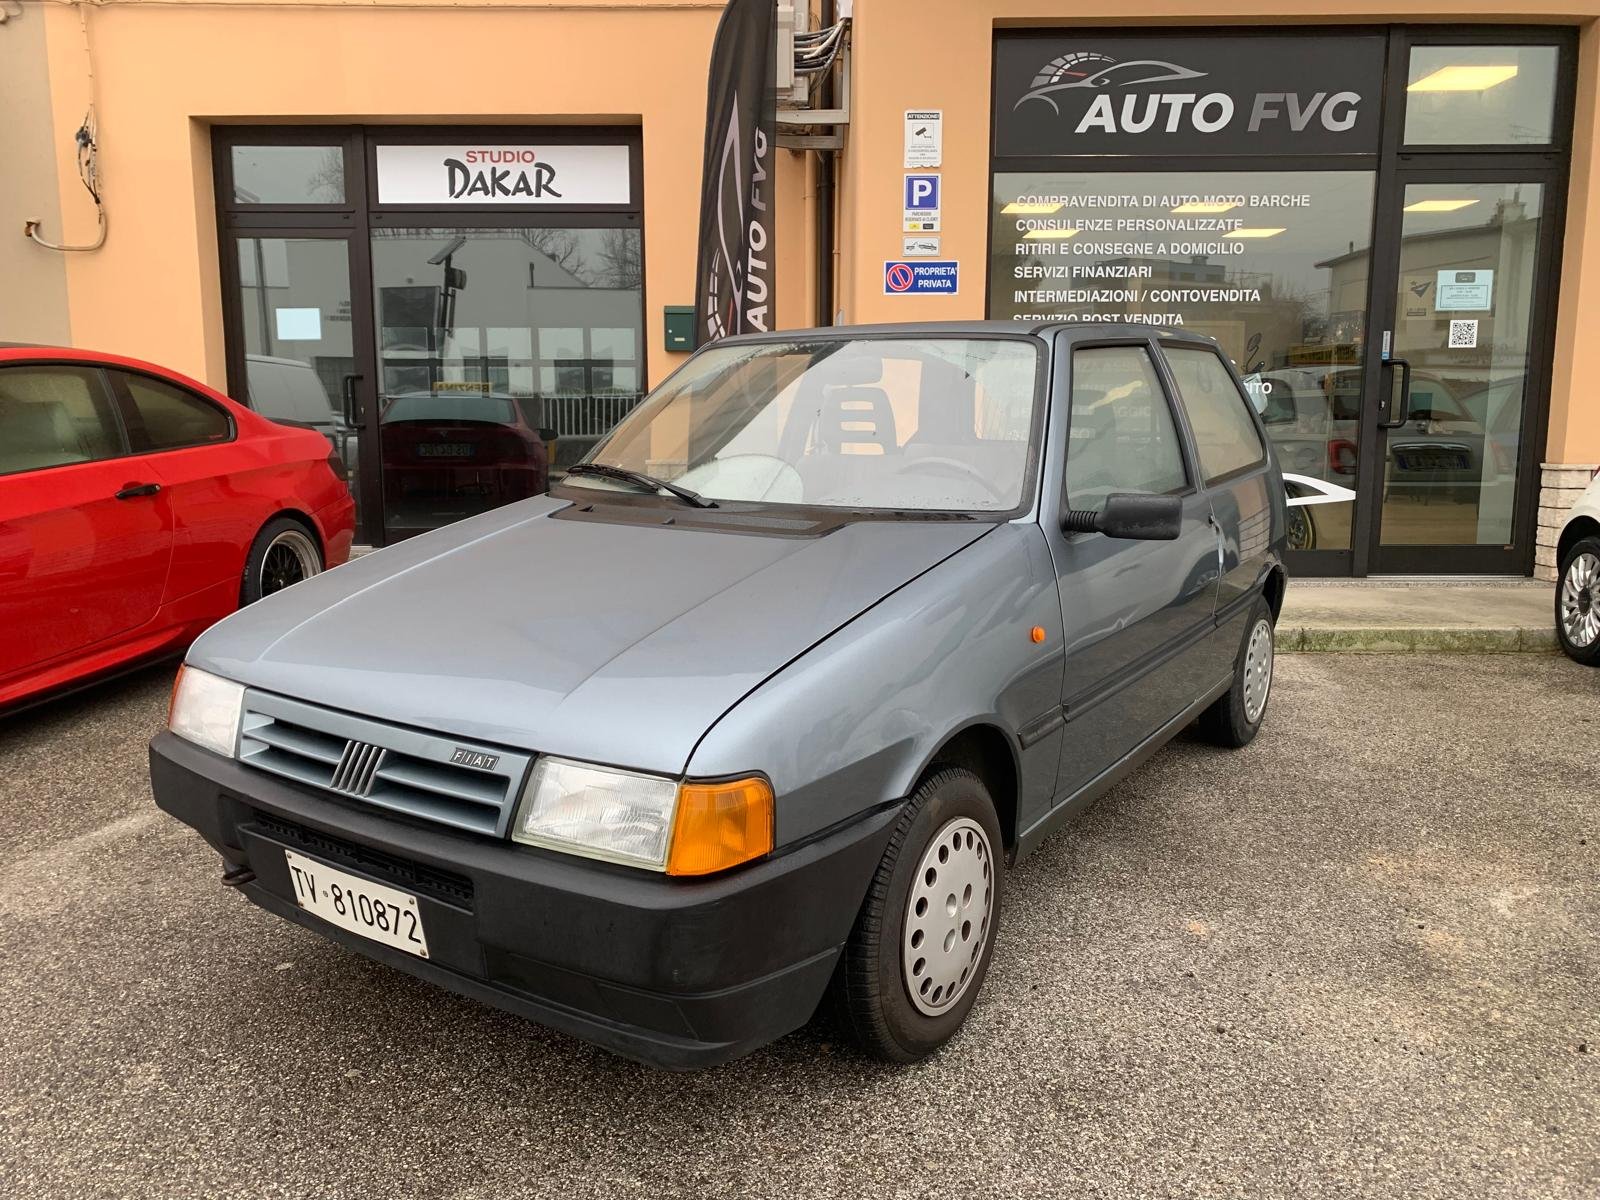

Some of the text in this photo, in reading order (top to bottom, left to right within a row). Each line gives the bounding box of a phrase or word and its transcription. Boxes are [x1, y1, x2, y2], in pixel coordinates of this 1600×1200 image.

[1074, 91, 1362, 134] AUTO FVG
[465, 150, 535, 163] STUDIO
[443, 158, 562, 198] DAKAR
[912, 179, 933, 206] P
[1016, 194, 1311, 208] COMPRAVENDITA DI AUTO MOTO BARCHE
[746, 126, 768, 333] AUTO FVG
[1015, 218, 1244, 232] CONSULENZE PERSONALIZZATE
[1015, 242, 1245, 255] RITIRI E CONSEGNE A DOMICILIO
[1013, 265, 1153, 278] SERVIZI FINANZIARI
[917, 279, 952, 288] PRIVATA
[1014, 290, 1139, 303] INTERMEDIAZIONI
[1150, 289, 1261, 303] CONTOVENDITA
[1123, 313, 1184, 326] VENDITA
[453, 751, 495, 768] FIAT
[291, 865, 422, 944] TV 810872
